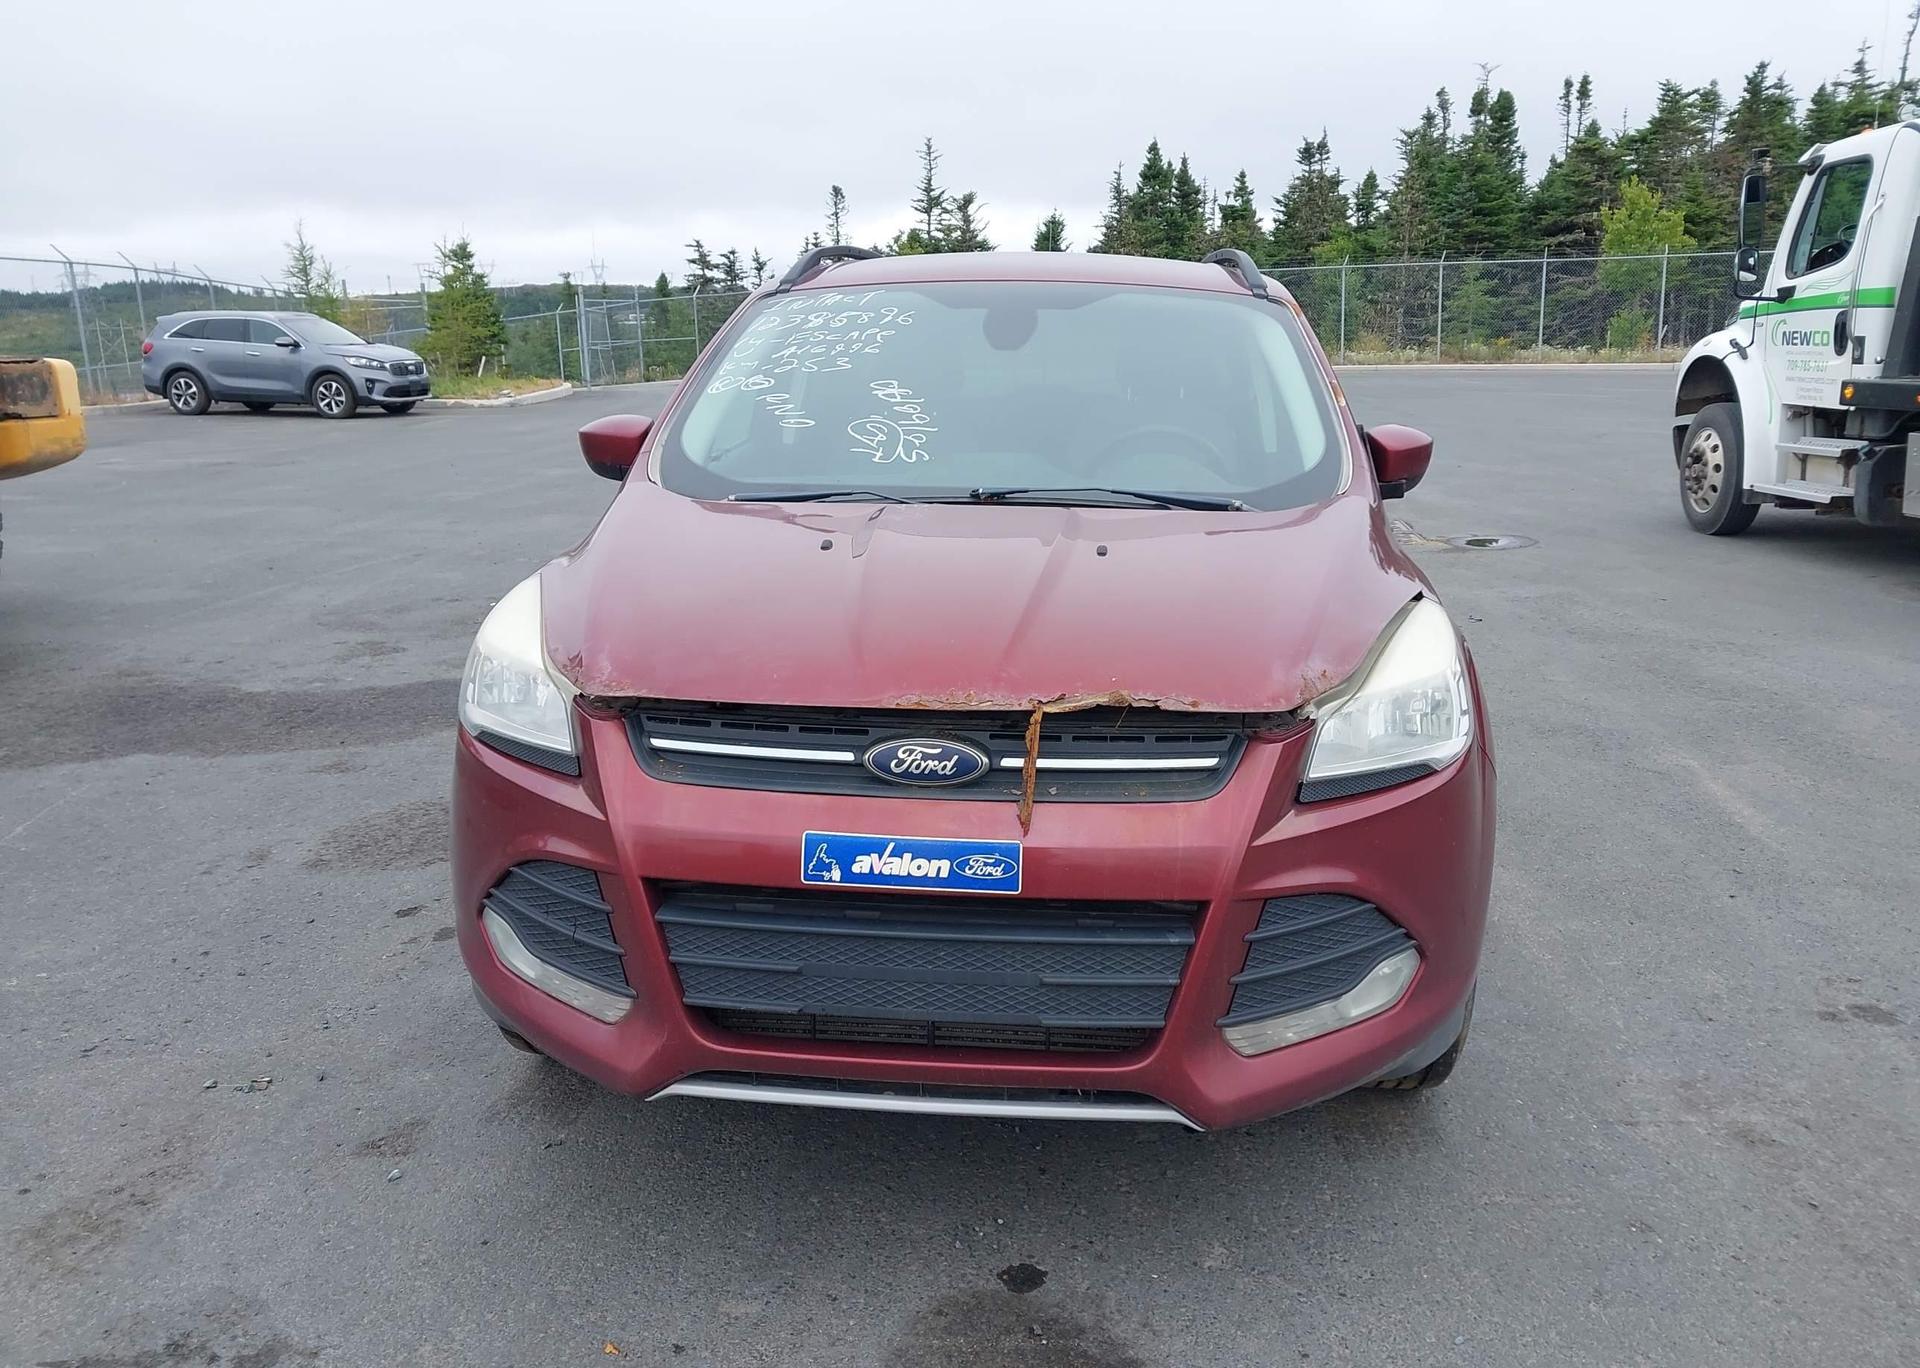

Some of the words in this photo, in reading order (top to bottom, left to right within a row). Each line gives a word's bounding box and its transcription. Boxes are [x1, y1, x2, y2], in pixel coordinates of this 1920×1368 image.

[1781, 330, 1830, 347] NEWCO
[890, 745, 959, 777] Ford
[964, 856, 1006, 877] Ford
